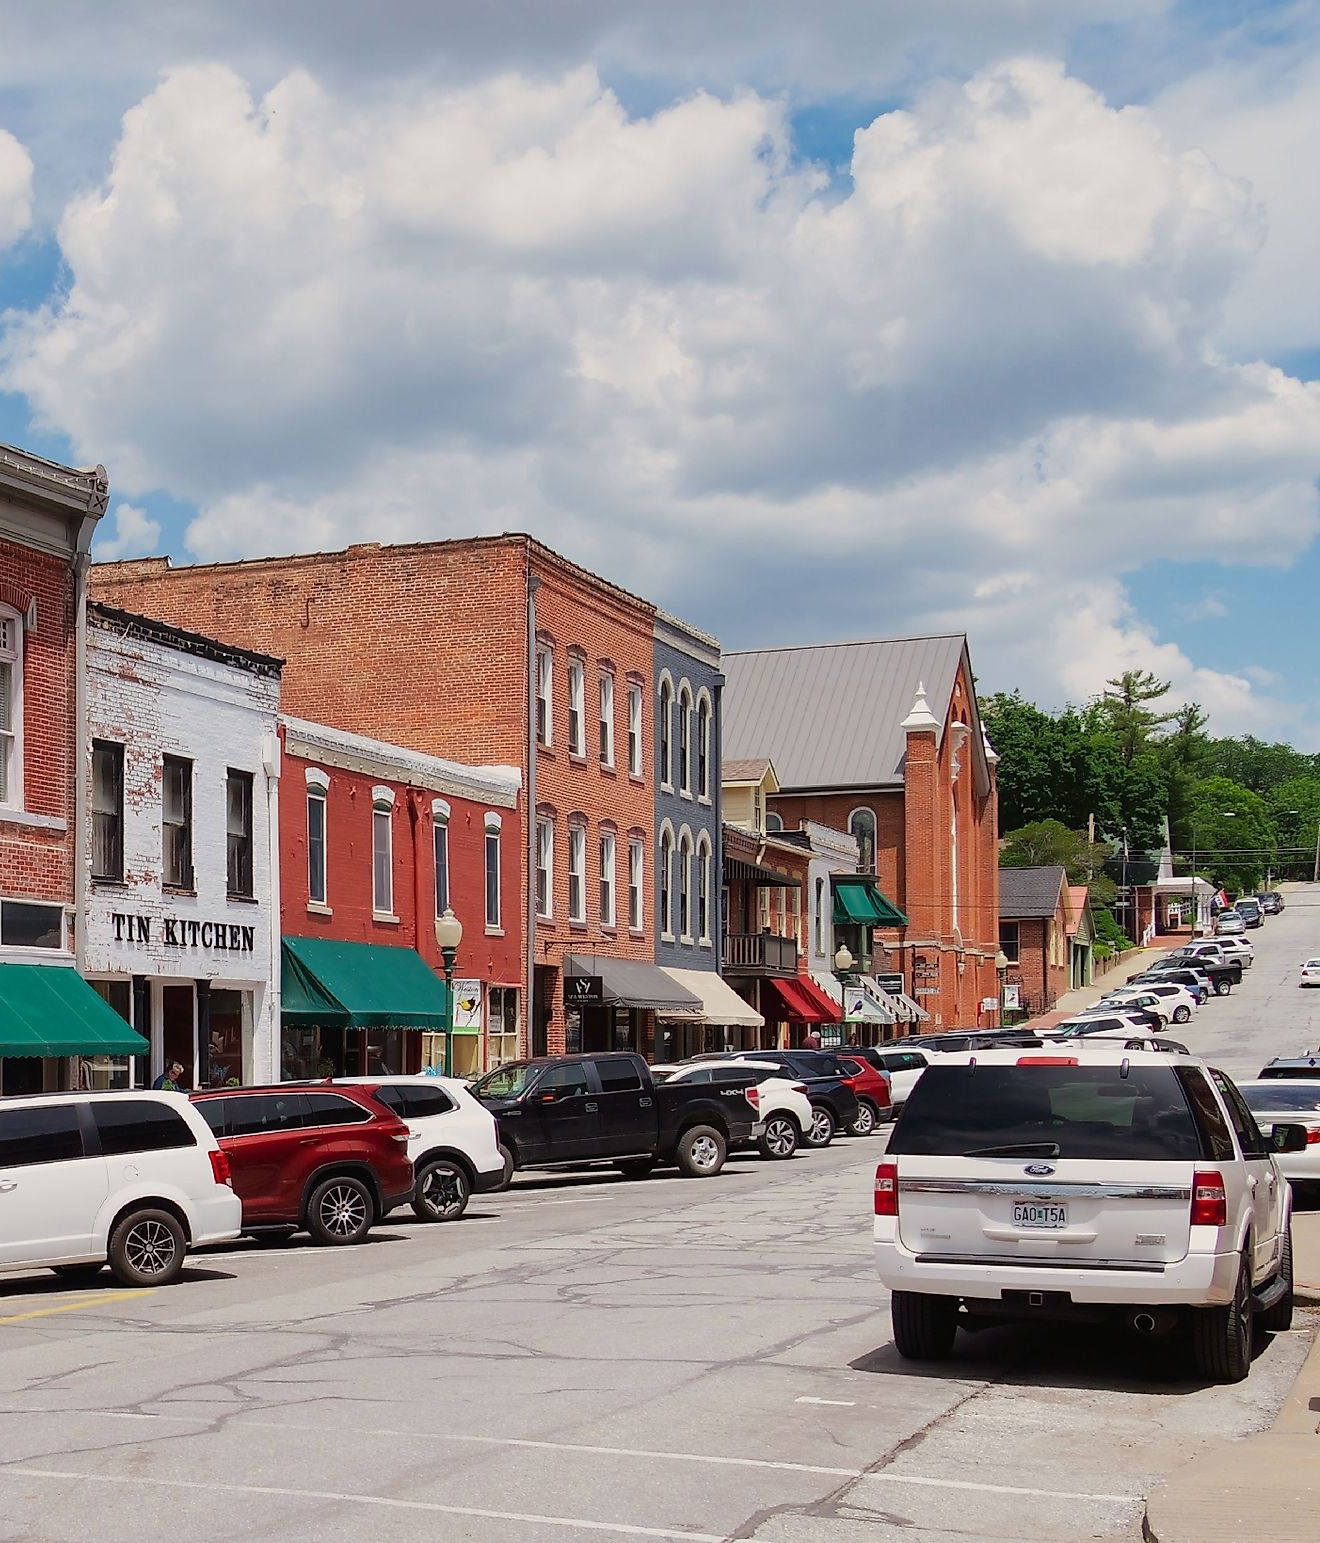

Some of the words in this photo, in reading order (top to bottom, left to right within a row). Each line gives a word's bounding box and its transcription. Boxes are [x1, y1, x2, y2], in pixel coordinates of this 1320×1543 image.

[112, 912, 151, 943] TIN
[164, 918, 256, 951] KITCHEN
[1042, 1207, 1066, 1222] T5A
